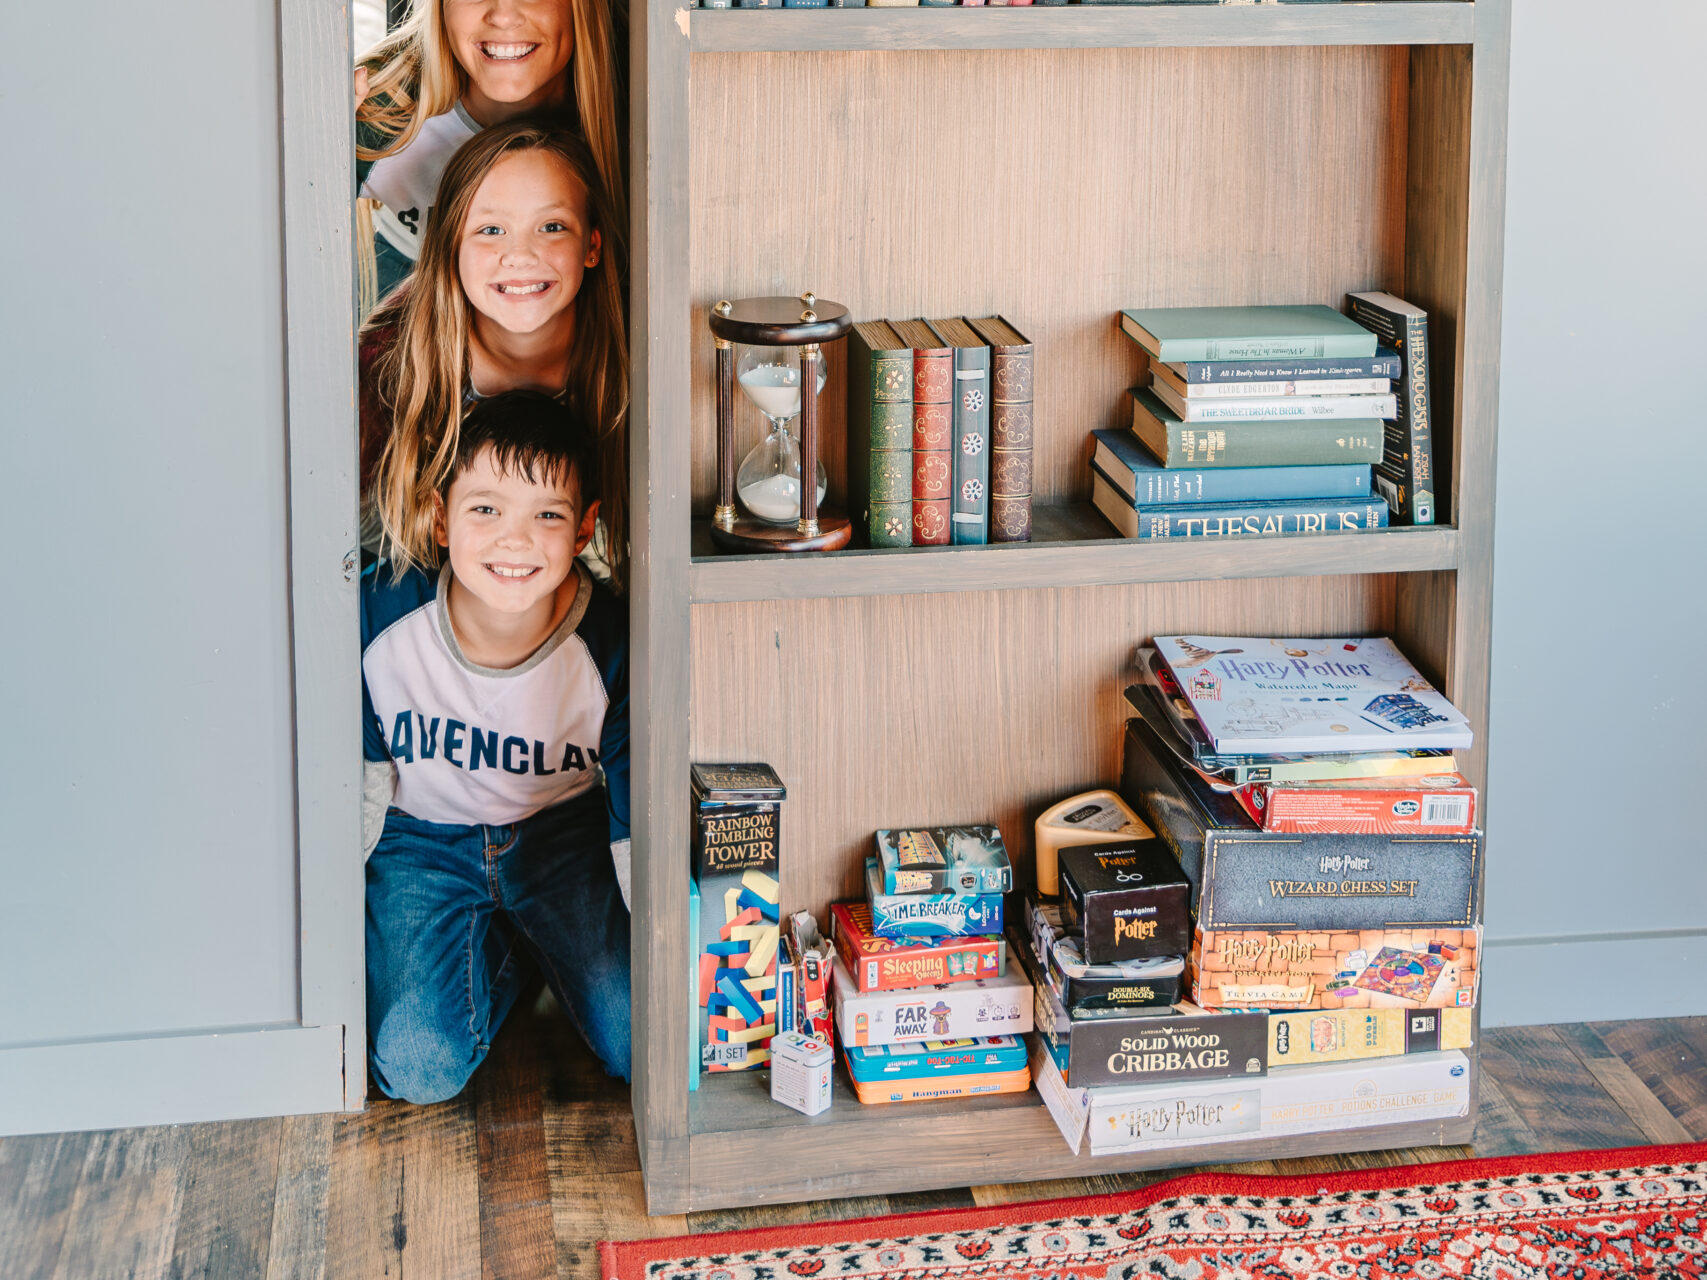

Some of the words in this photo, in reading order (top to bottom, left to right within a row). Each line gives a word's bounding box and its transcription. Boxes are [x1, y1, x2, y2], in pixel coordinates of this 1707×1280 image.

[1228, 349, 1249, 357] House
[1250, 348, 1262, 356] The
[1271, 347, 1297, 356] Woman
[1235, 369, 1253, 379] Really
[1253, 369, 1268, 377] Need
[1298, 368, 1319, 376] Learned
[1218, 384, 1241, 394] CLYDE
[1243, 382, 1280, 394] EDGERTON
[1410, 336, 1428, 431] HEXOLOGISTS
[1201, 408, 1219, 417] THE
[1219, 407, 1278, 417] SWEETBRIAR
[1279, 406, 1305, 416] BRIDE
[1311, 406, 1335, 415] Wilbee
[1198, 438, 1207, 451] the
[1413, 445, 1423, 487] BANCROFT
[1421, 451, 1429, 480] JOSIAH
[1177, 511, 1359, 537] THESAURUS
[1218, 658, 1289, 681] Harry
[1288, 658, 1373, 682] Potter
[1255, 682, 1318, 691] Watercolor
[1322, 683, 1360, 691] Magic
[378, 710, 600, 776] AVENCLA
[707, 814, 774, 832] RAINBOW
[704, 826, 775, 848] JUMBLING
[705, 841, 776, 865] TOWER
[743, 860, 765, 868] pieces
[1098, 856, 1137, 869] Potter
[1319, 856, 1344, 874] Harry
[1343, 855, 1370, 877] Potter
[1268, 880, 1338, 898] WIZARD
[1340, 880, 1386, 895] CHESS
[1390, 880, 1418, 897] SET
[882, 901, 917, 920] TIME
[919, 901, 966, 917] BREAKER
[1113, 909, 1132, 917] Cards
[1132, 906, 1157, 915] Against
[1114, 916, 1158, 947] Potter
[1217, 938, 1265, 965] Harry
[1264, 935, 1316, 969] Potter
[882, 956, 944, 980] Sleeping
[1107, 991, 1155, 1001] DOMINOES
[1112, 986, 1150, 994] DOUBLE-SIX
[1225, 990, 1267, 998] TRIVIA
[895, 1006, 927, 1024] FAR
[893, 1023, 928, 1036] AWAY
[1120, 1037, 1169, 1052] SOLID
[1171, 1034, 1220, 1049] WOOD
[718, 1049, 722, 1059] 1
[726, 1047, 745, 1058] SET
[1107, 1049, 1230, 1074] CRIBBAGE
[1271, 1108, 1300, 1121] HARRY
[1301, 1104, 1335, 1119] POTTER
[1341, 1099, 1377, 1112] POTIONS
[1379, 1094, 1428, 1109] CHALLENGE
[1433, 1089, 1457, 1102] GAME
[1126, 1108, 1174, 1138] Harry
[1175, 1100, 1224, 1137] Potter
